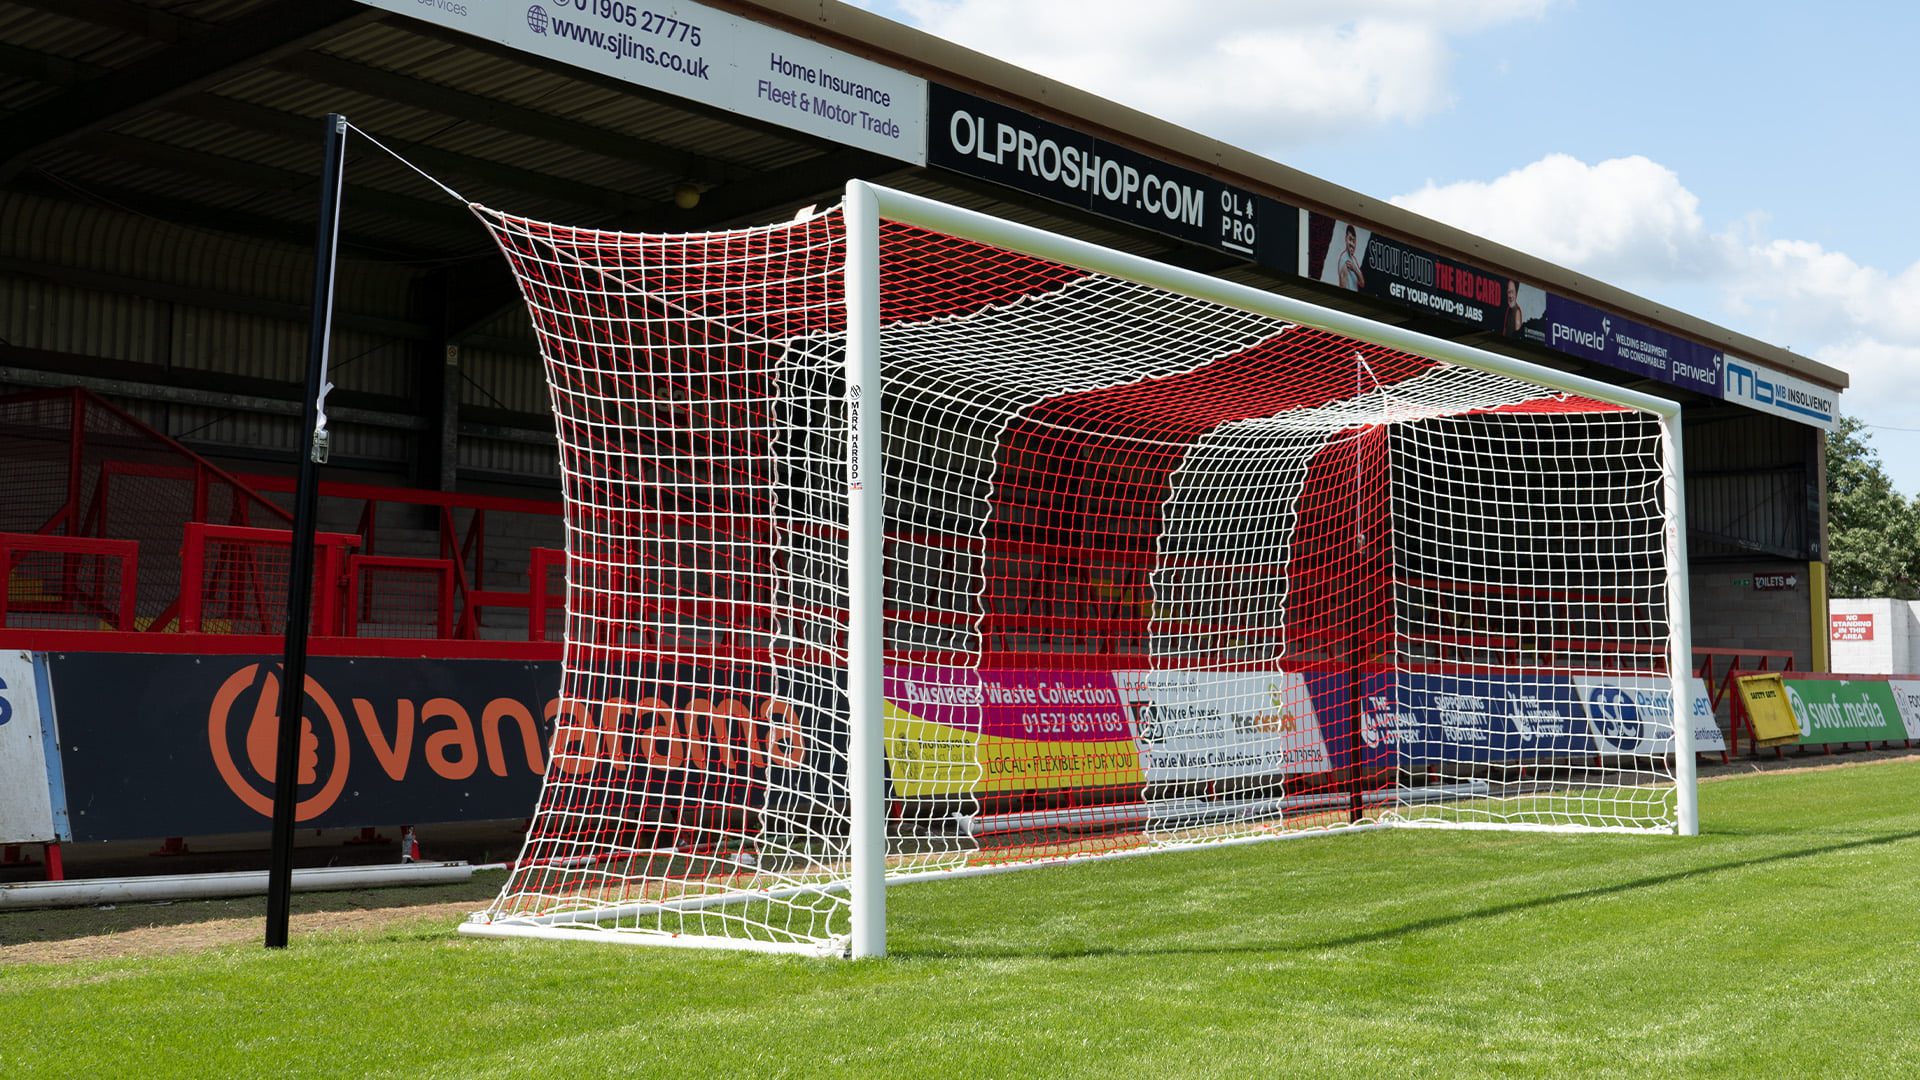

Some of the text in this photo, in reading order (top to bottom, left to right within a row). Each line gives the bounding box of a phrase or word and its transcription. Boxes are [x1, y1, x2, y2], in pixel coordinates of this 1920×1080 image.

[417, 0, 468, 17] ervices
[575, 0, 702, 47] 01905 27775
[552, 17, 710, 80] www.sjlins.co.uk
[770, 52, 891, 107] Home Insurance
[758, 80, 900, 139] Fleet & Motor Trade
[950, 110, 1204, 227] OLPROSHOP.COM
[1222, 215, 1255, 245] PRO
[1369, 240, 1501, 307] SHOW COVID THE RED CARD
[1389, 282, 1483, 322] GET YOUR COVID-19 JABS
[1552, 322, 1605, 351] parweld
[1615, 333, 1668, 359] WELDING EQUIPMENT
[1618, 347, 1666, 370] AND CONSUMABLES
[1672, 360, 1716, 385] parweld
[1775, 384, 1832, 413] MB INSOLVENCY
[851, 401, 860, 431] MARK
[851, 434, 859, 479] HARROD
[1754, 576, 1784, 588] TOILETS
[1832, 620, 1872, 628] STANDING
[904, 681, 1116, 704] Business Waste Collection
[1369, 696, 1391, 710] THE
[1434, 696, 1484, 710] SUPPORTING
[1021, 712, 1123, 734] 01527 881188
[1160, 705, 1187, 724] Wyre
[1375, 712, 1419, 727] NATIONAL
[1440, 712, 1488, 726] COMMUNITY
[1808, 693, 1888, 729] swof.media
[353, 697, 805, 782] vanarama
[1381, 729, 1420, 744] LOTTERY
[1444, 727, 1487, 741] FOOTBALL
[989, 756, 1024, 774] LOCAL
[1033, 755, 1080, 772] FLEXIBLE
[1088, 753, 1108, 770] FOR
[1110, 752, 1133, 768] YOU
